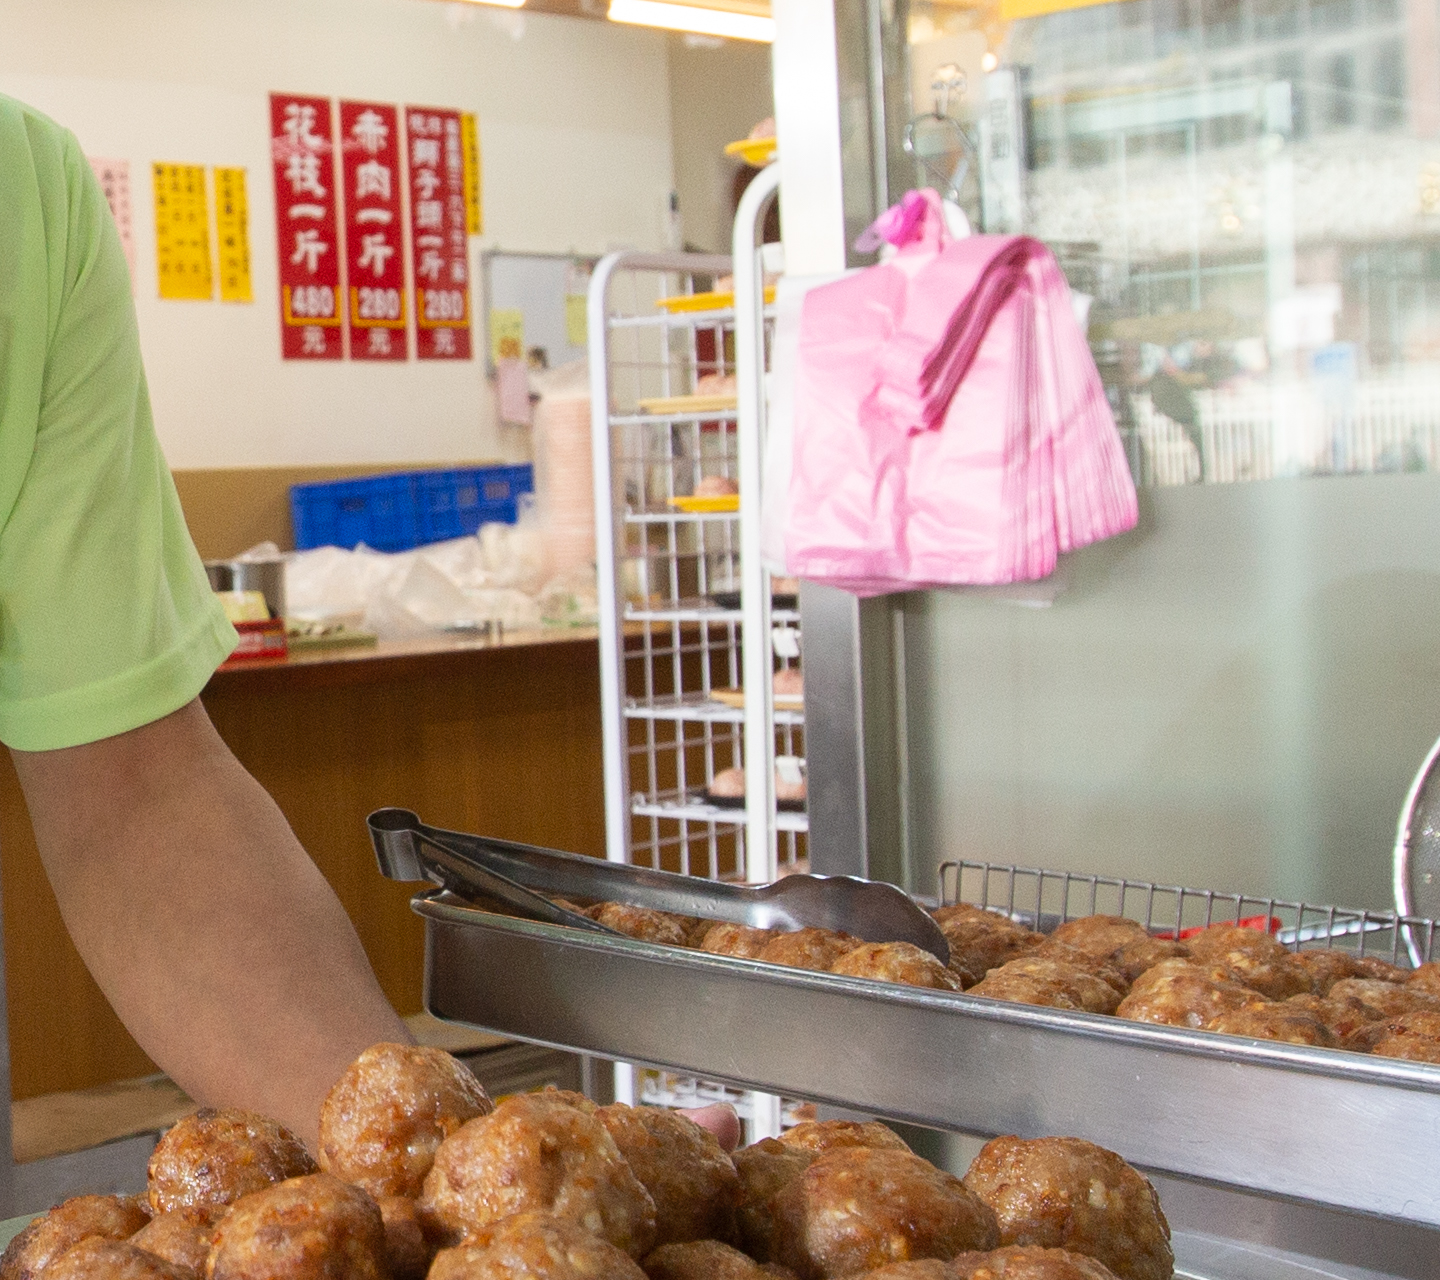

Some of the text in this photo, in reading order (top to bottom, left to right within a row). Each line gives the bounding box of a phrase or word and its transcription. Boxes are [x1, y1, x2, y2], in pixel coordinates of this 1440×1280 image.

[282, 102, 328, 275] 花枝一斤
[352, 109, 395, 278] 赤肉一斤
